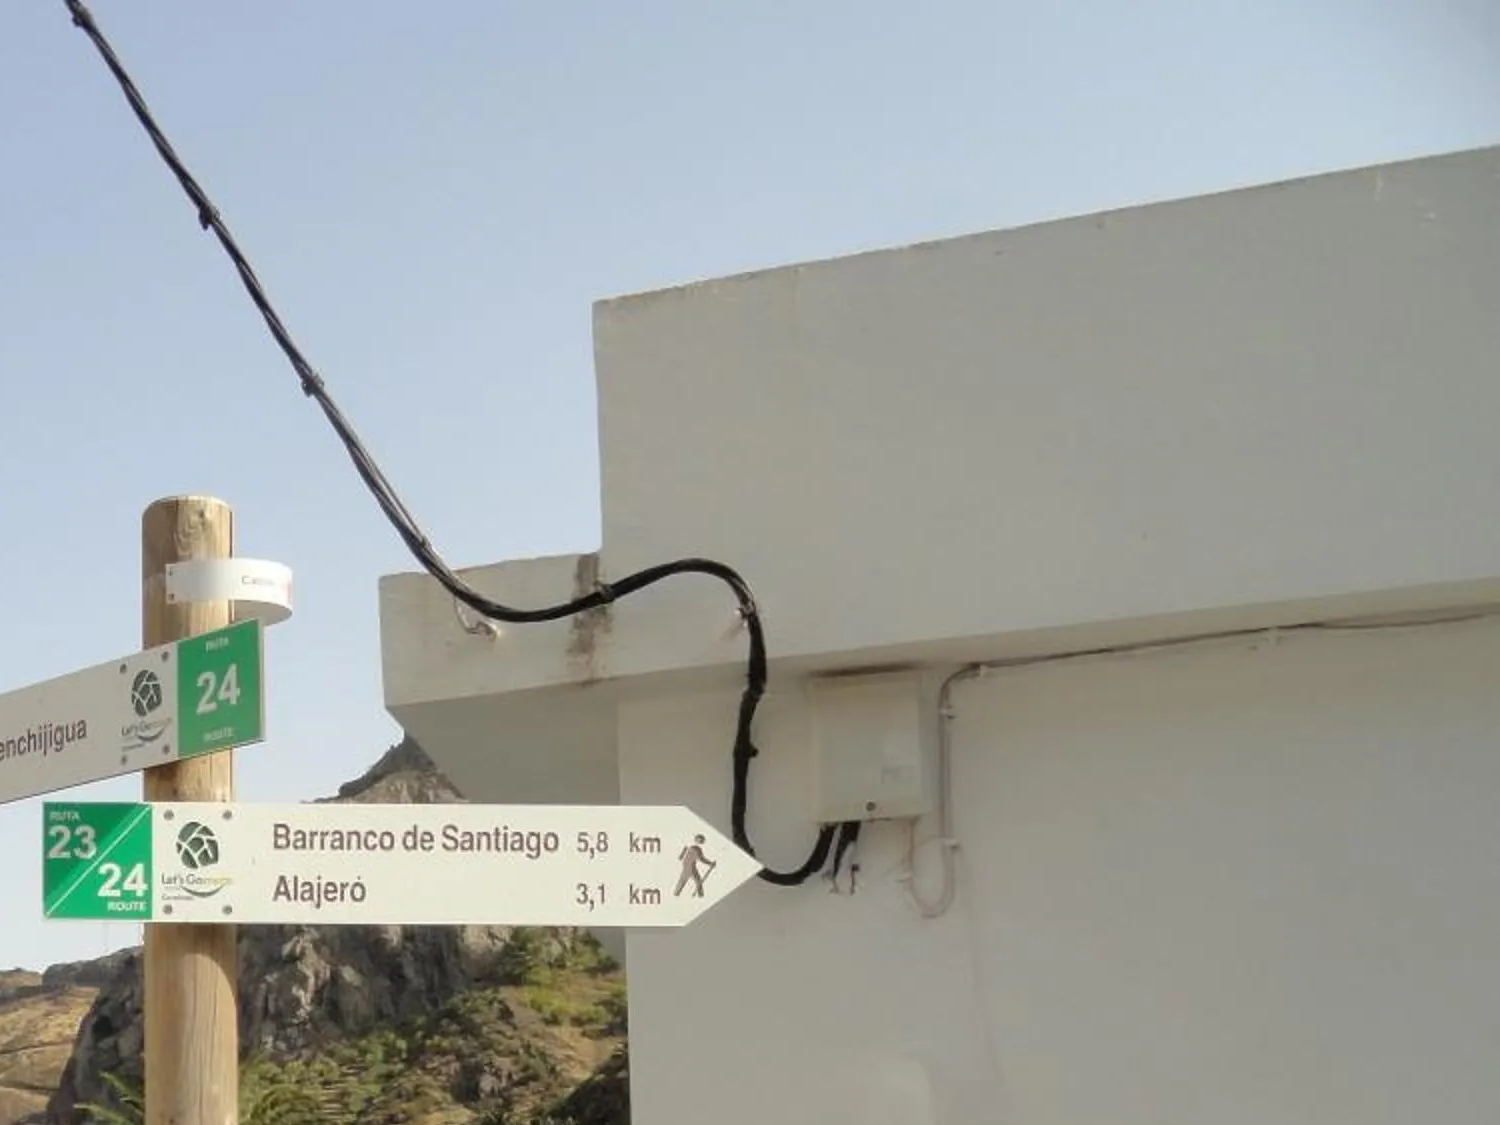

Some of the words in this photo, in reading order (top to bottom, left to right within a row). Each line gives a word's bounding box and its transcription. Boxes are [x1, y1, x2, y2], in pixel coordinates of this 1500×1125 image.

[196, 663, 241, 716] 24
[49, 811, 80, 821] RUTA
[47, 824, 97, 859] 23
[272, 823, 395, 851] Barranco
[402, 824, 435, 851] de
[441, 824, 560, 860] Santiago
[577, 831, 609, 859] 5,8
[629, 831, 661, 853] km
[97, 862, 149, 897] 24
[271, 874, 367, 909] Alajeró
[576, 883, 606, 912] 3,1
[629, 883, 661, 905] km
[107, 901, 148, 912] ROUTE
